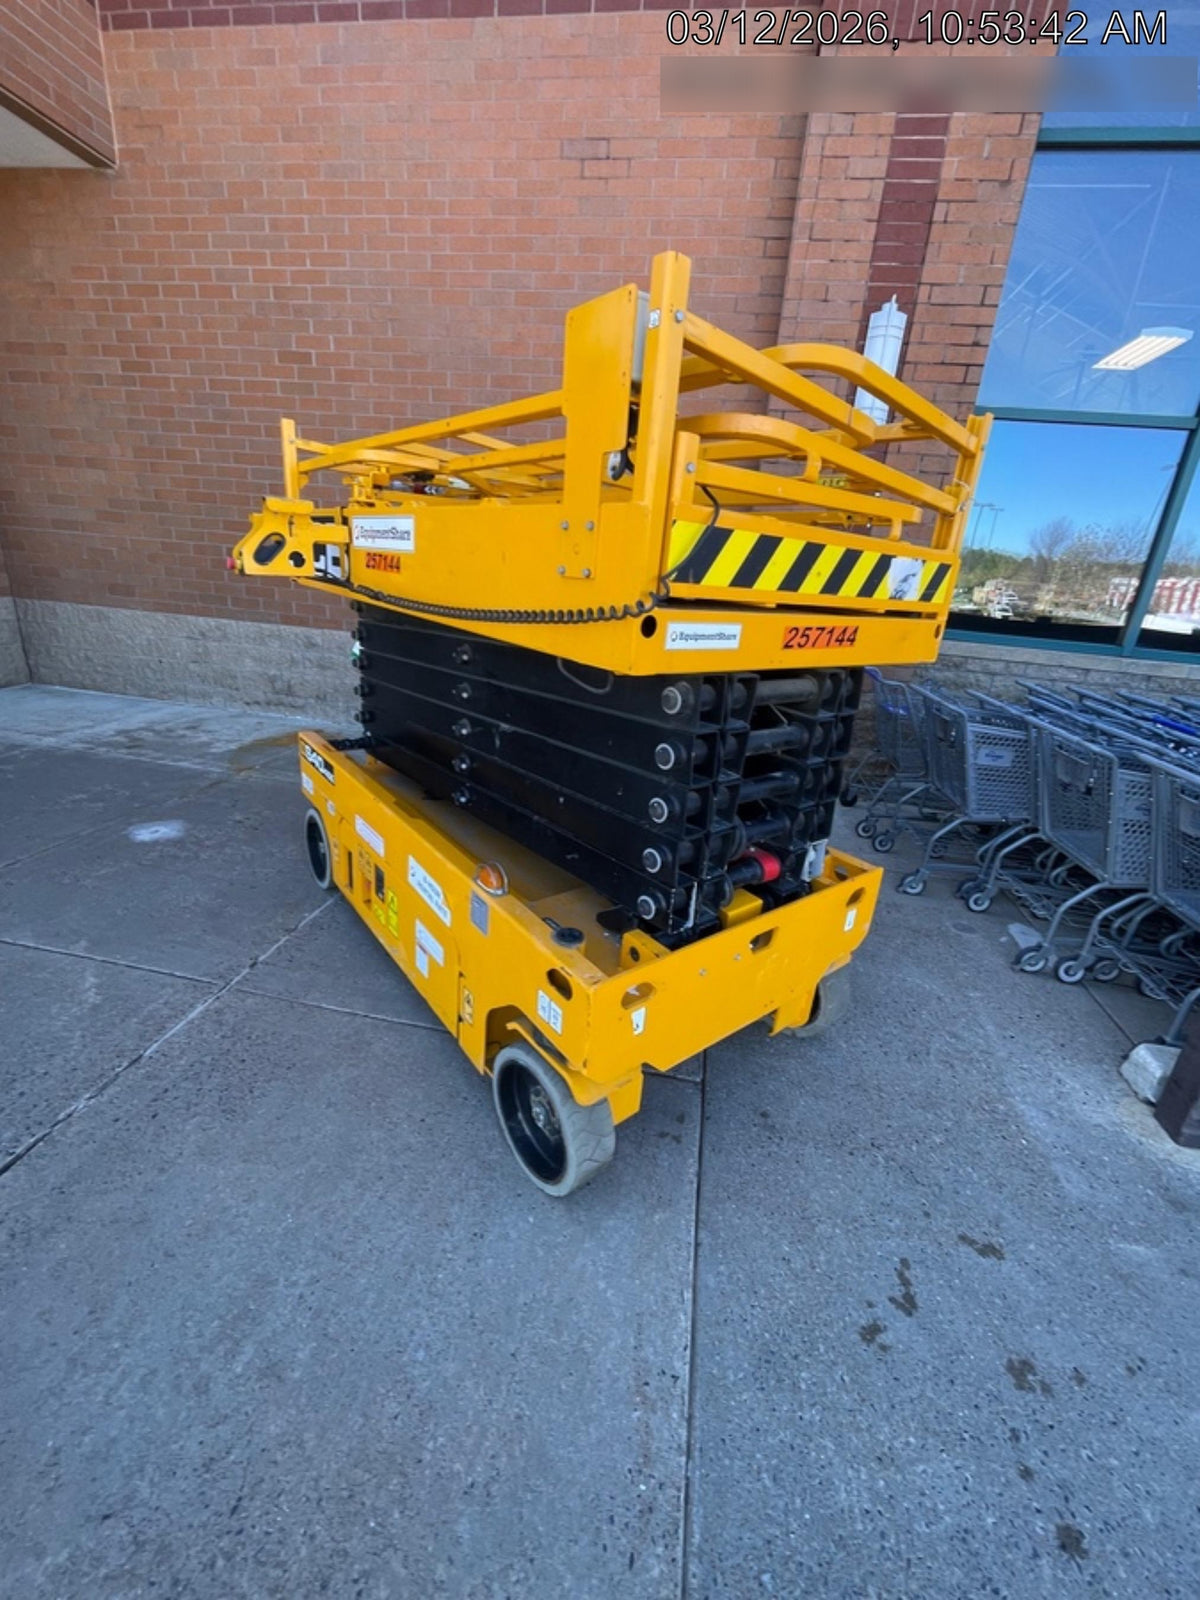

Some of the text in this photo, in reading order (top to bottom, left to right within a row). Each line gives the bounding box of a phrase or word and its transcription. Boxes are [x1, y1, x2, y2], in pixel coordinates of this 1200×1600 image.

[366, 552, 401, 572] 257144
[678, 631, 737, 643] EquipmentShare
[783, 626, 860, 650] 257144
